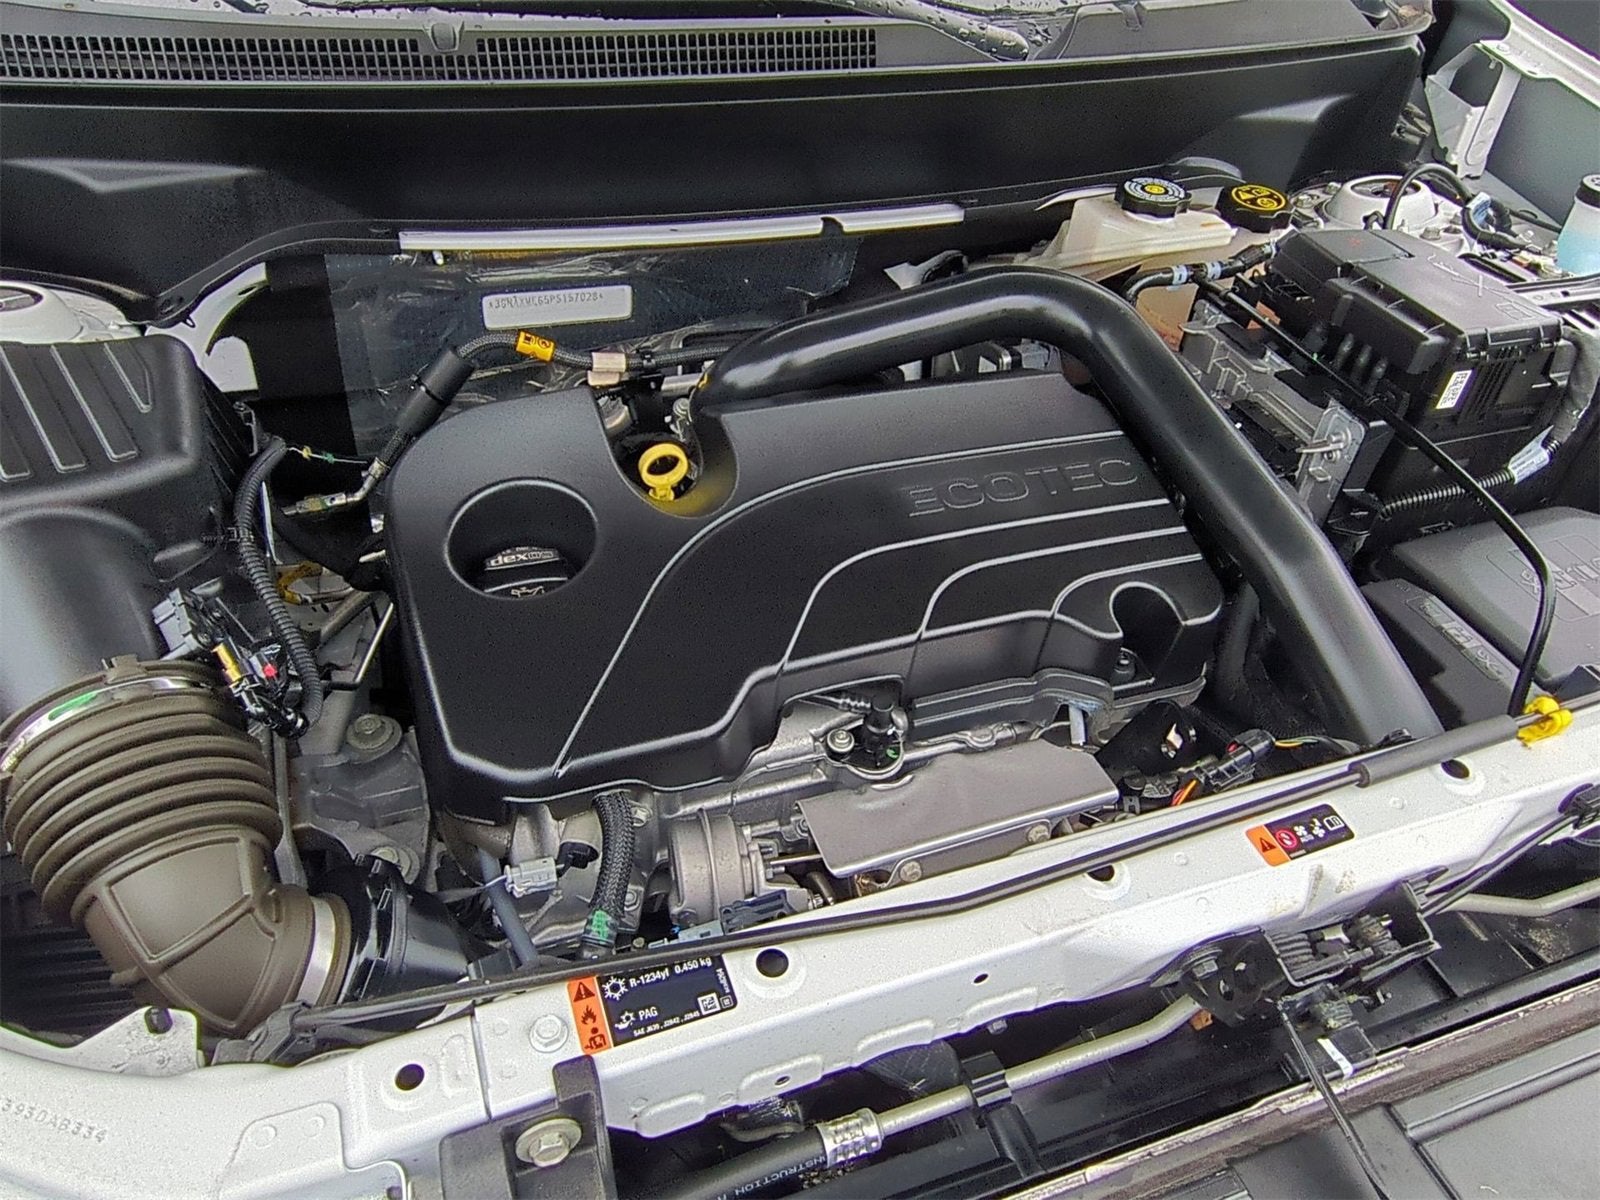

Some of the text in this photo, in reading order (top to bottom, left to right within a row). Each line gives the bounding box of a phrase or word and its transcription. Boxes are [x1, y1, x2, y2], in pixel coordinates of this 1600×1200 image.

[900, 459, 1138, 517] ECOTEC
[674, 961, 699, 974] 0.450
[699, 958, 713, 967] kg
[638, 1006, 658, 1021] PAG
